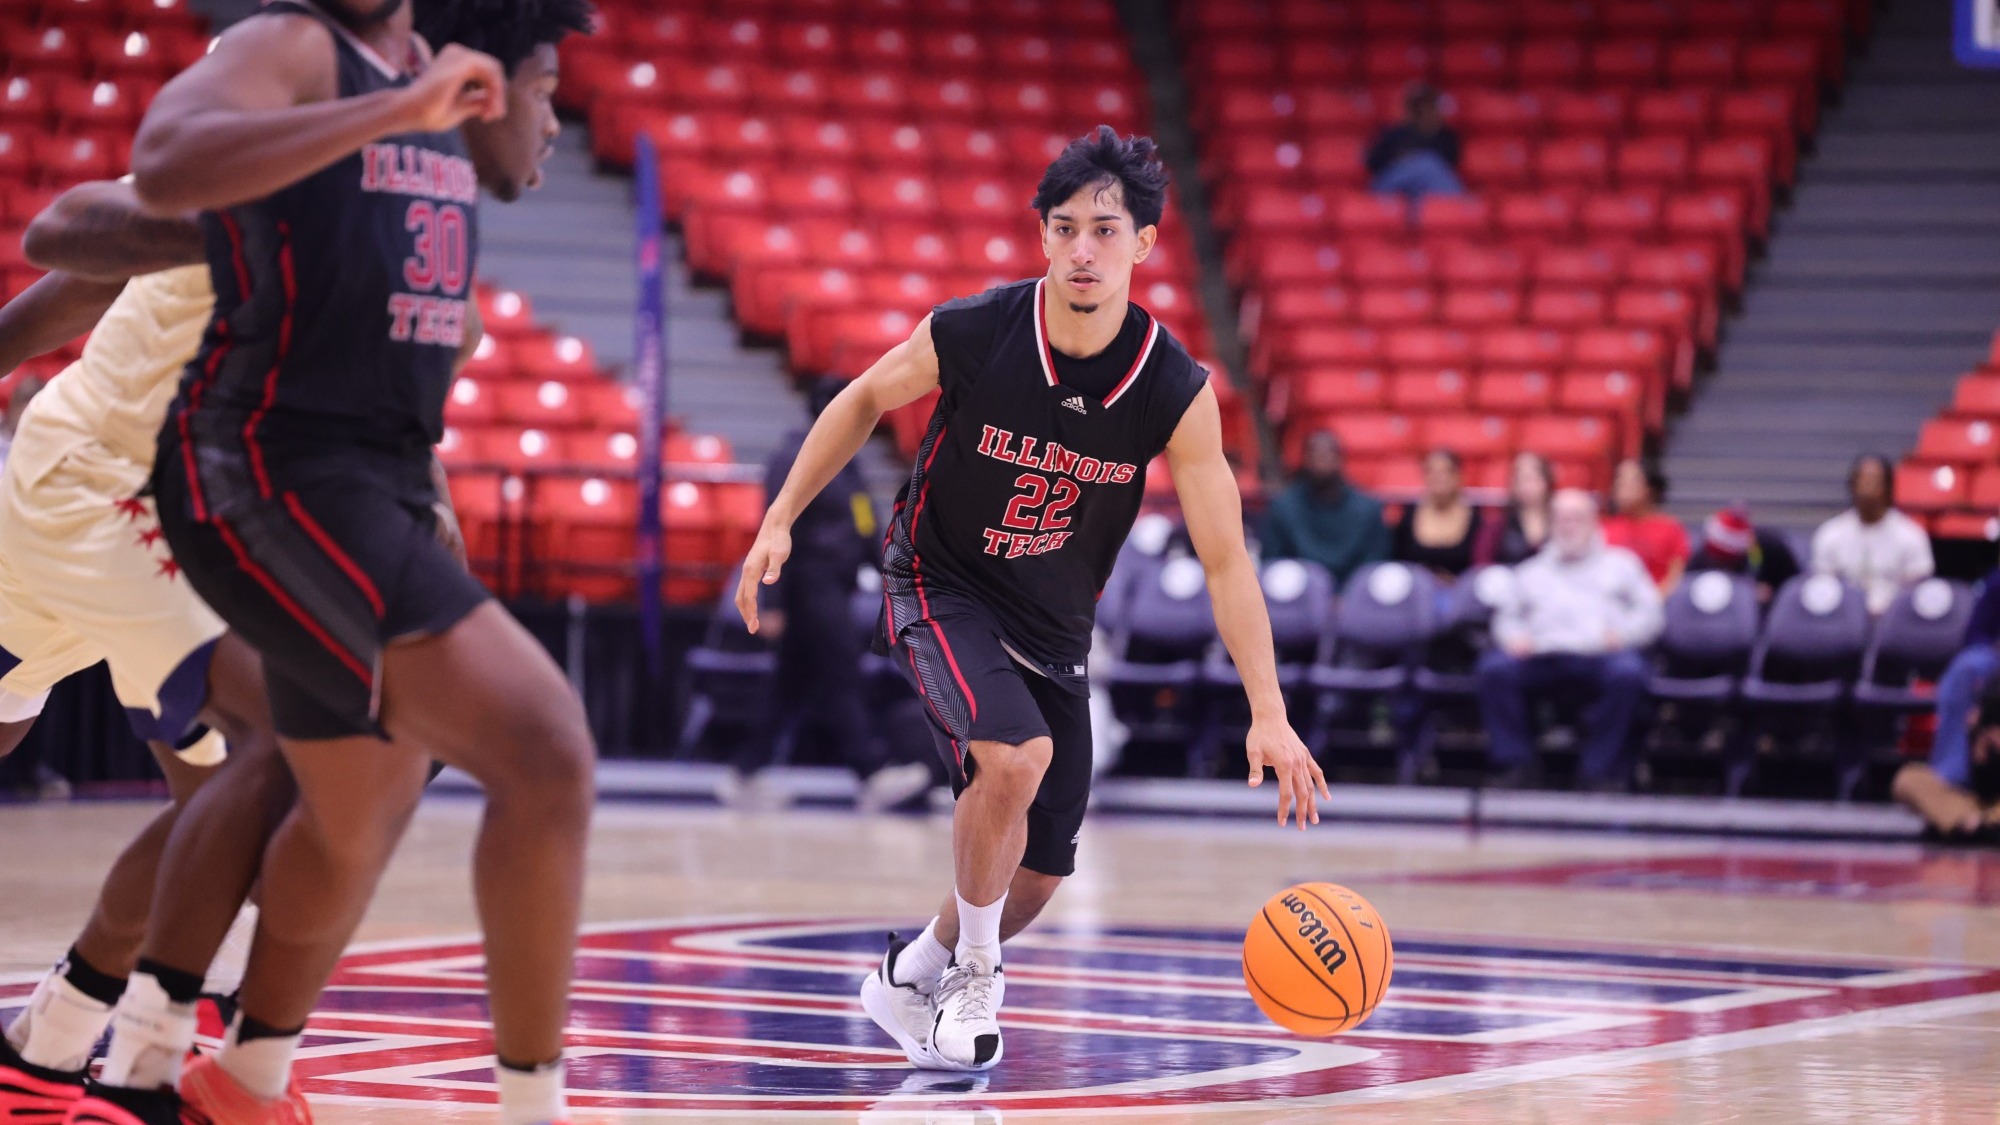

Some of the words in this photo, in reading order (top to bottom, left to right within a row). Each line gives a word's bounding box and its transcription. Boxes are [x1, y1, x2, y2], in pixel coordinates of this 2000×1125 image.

[403, 200, 468, 295] 30
[1061, 400, 1087, 415] adidas
[977, 424, 1137, 484] ILLINOIS
[1002, 472, 1081, 531] 22
[983, 527, 1073, 559] TECH
[1280, 893, 1347, 976] Wilson
